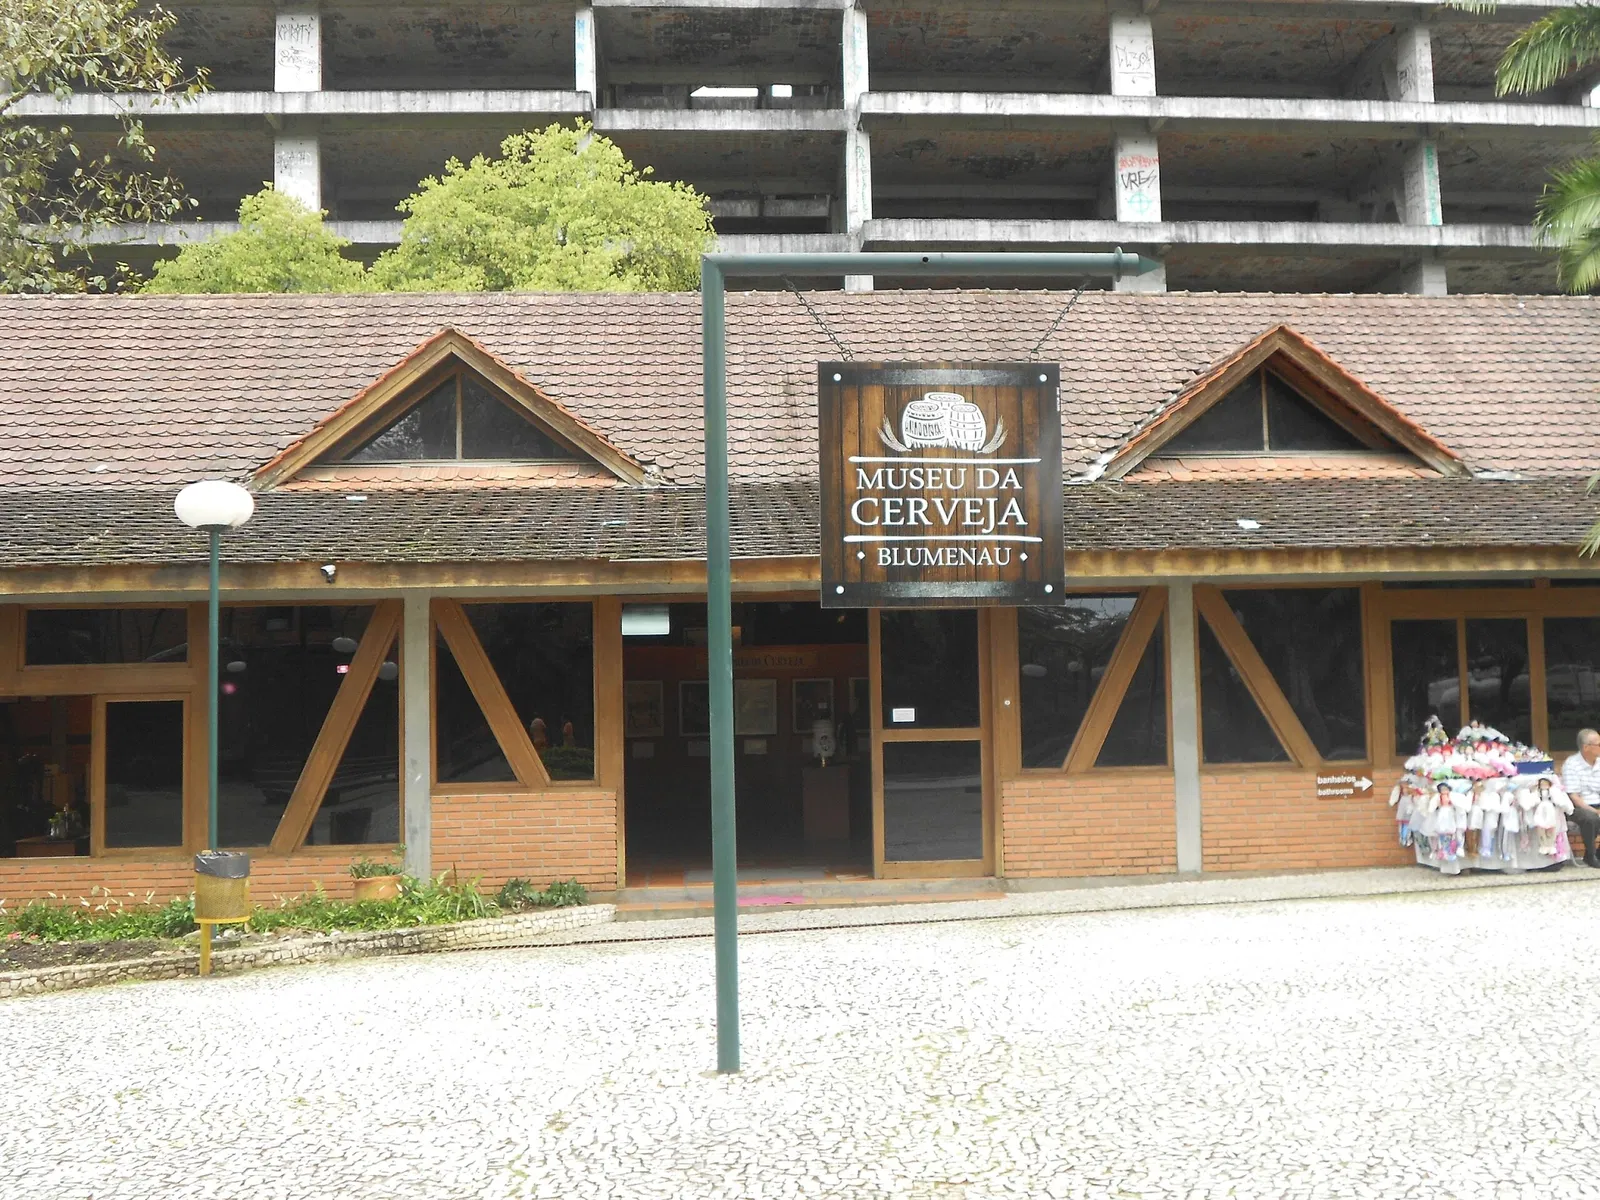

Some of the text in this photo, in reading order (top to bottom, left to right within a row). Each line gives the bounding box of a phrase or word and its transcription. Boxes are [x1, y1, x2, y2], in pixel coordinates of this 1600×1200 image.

[856, 467, 1023, 490] MUSEU DA
[851, 497, 1028, 534] CERVEJA
[877, 547, 1012, 566] BLUMENAU
[1317, 776, 1356, 784] banheiros
[1318, 788, 1354, 796] bathrooms
